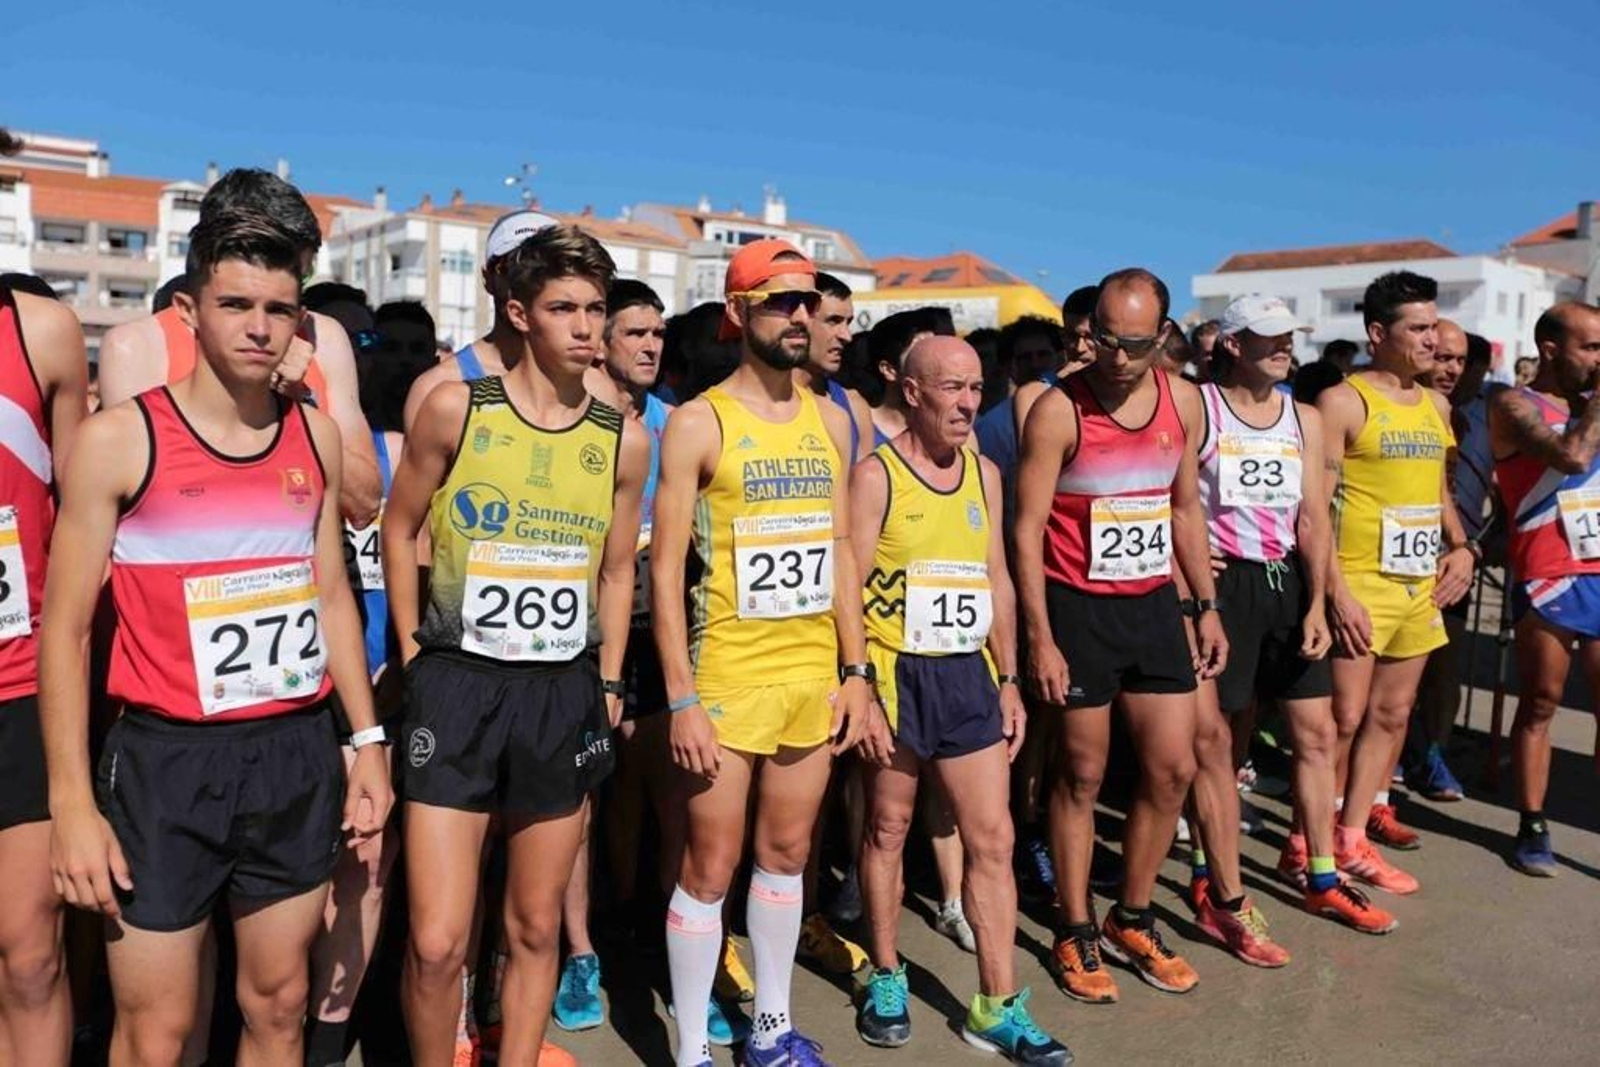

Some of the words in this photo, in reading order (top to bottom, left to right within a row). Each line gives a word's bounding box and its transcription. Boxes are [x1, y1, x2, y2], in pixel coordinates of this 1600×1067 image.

[743, 458, 832, 479] ATHLETICS
[1239, 459, 1284, 487] 83
[746, 482, 777, 501] SAN
[455, 490, 510, 534] Sg
[1576, 511, 1600, 539] 1
[1100, 524, 1166, 559] 234
[1392, 529, 1440, 558] 169
[749, 547, 826, 592] 237
[475, 585, 578, 631] 269
[931, 592, 977, 628] 15
[209, 608, 320, 677] 272
